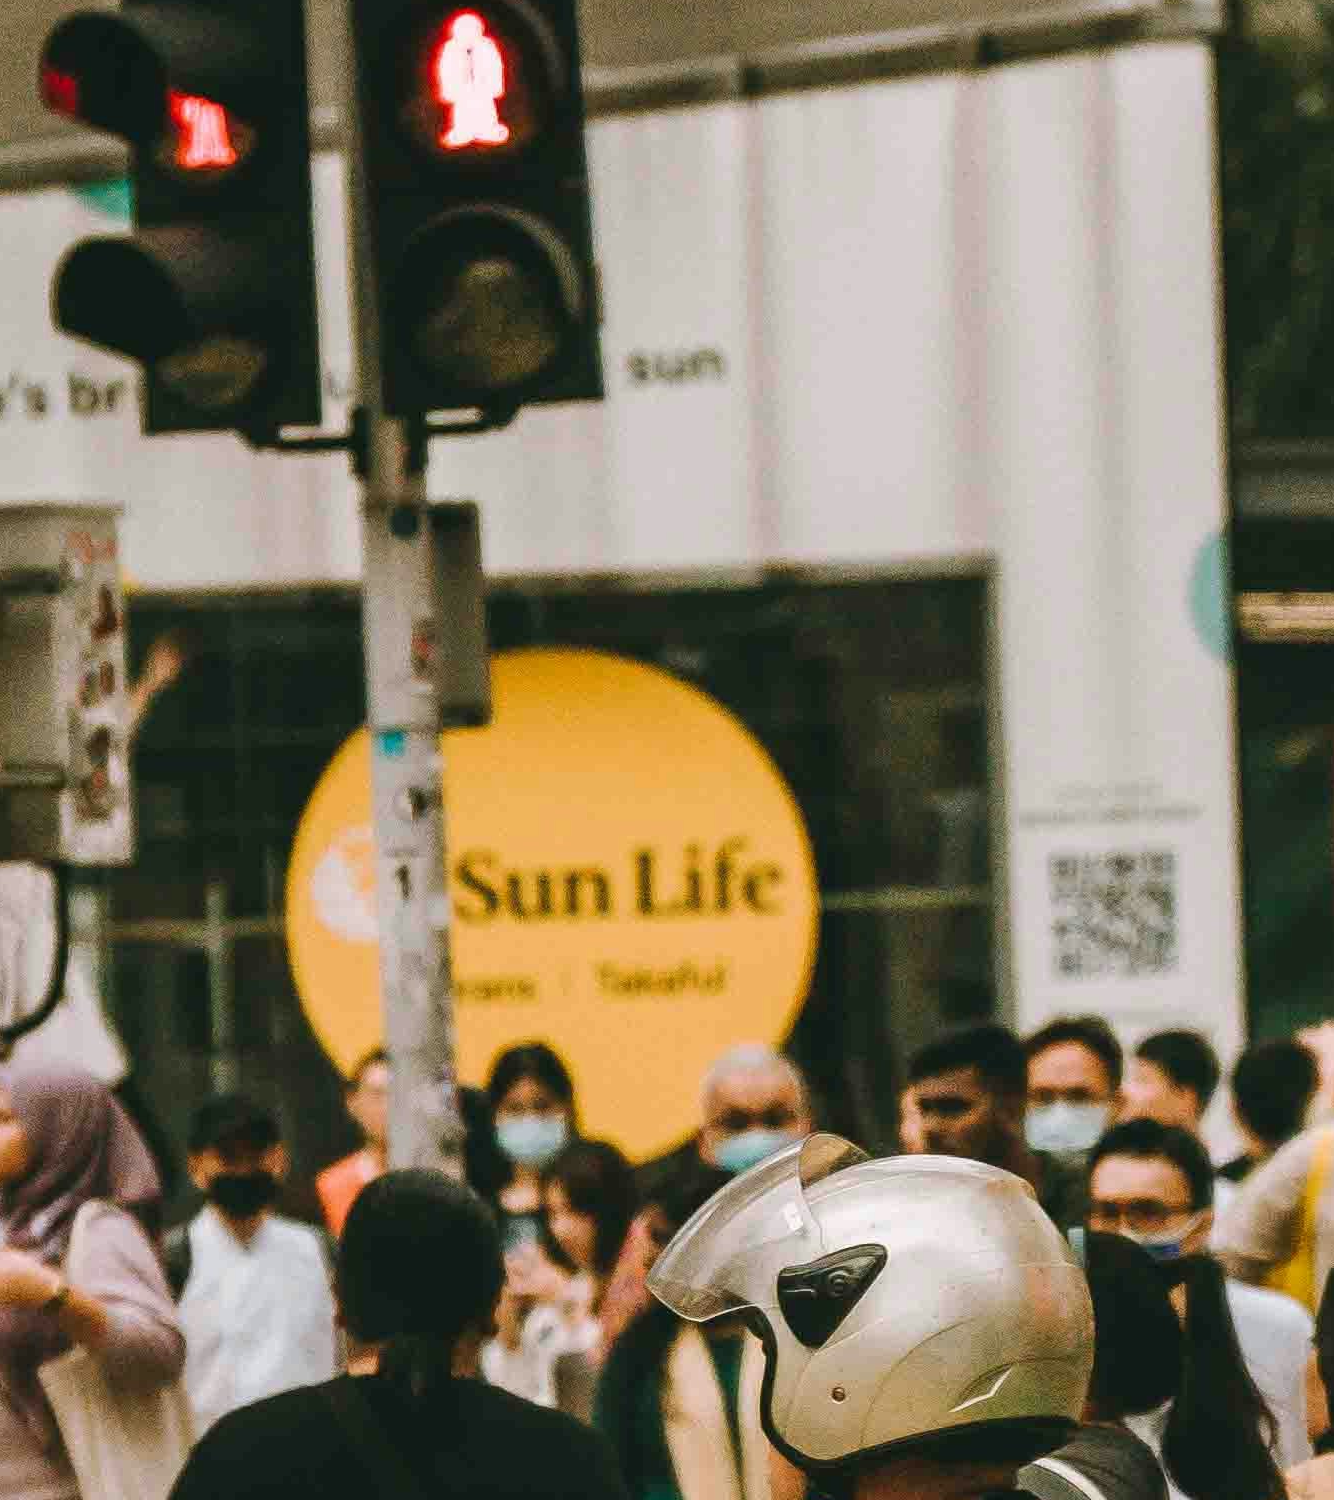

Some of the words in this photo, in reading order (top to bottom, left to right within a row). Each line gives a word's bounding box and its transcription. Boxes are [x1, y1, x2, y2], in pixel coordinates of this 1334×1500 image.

[625, 347, 727, 386] sun
[454, 846, 613, 925] Sun
[633, 834, 781, 918] Life
